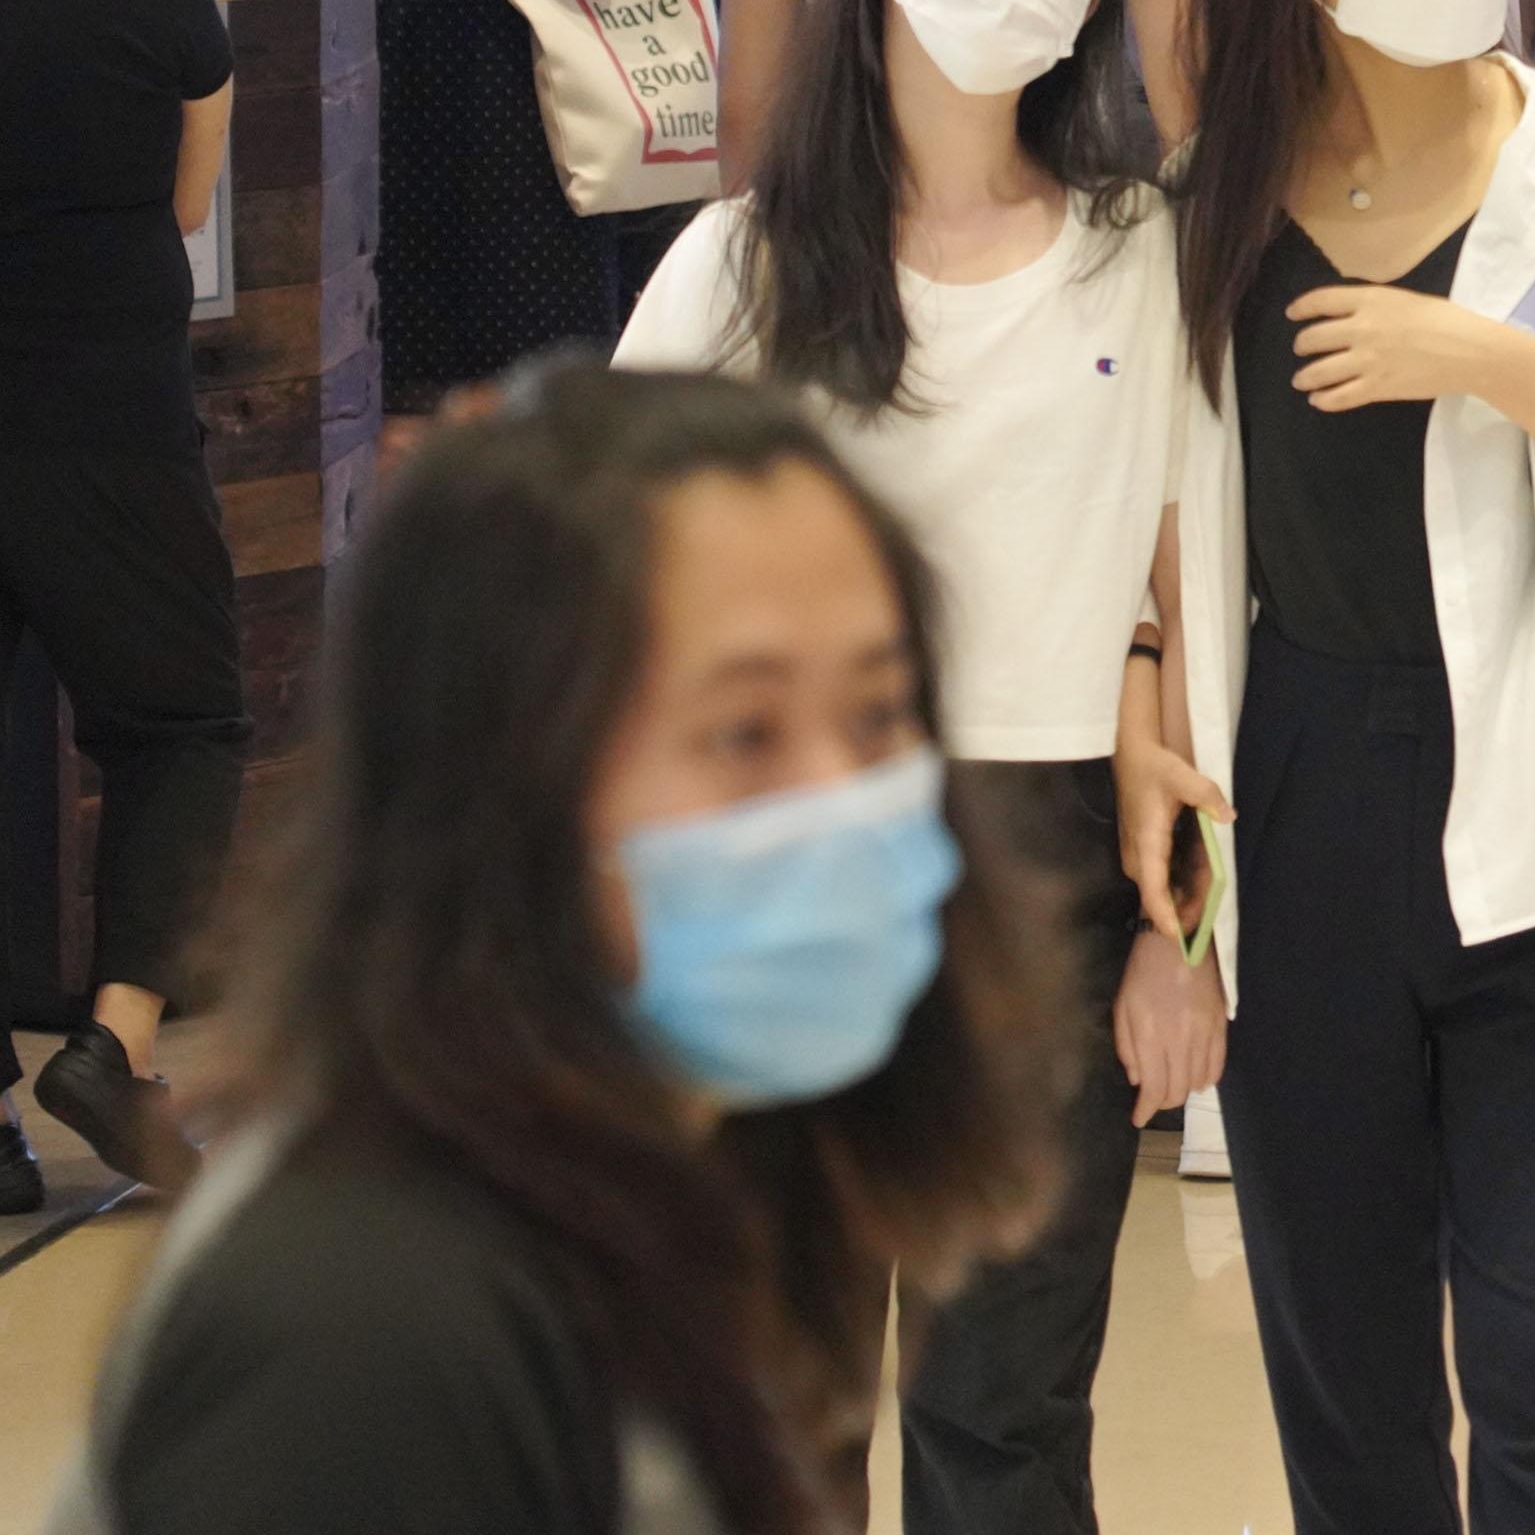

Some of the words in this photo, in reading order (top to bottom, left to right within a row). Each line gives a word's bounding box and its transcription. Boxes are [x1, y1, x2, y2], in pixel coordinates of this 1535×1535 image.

[642, 34, 666, 56] a
[631, 50, 710, 98] good
[656, 103, 714, 138] time
